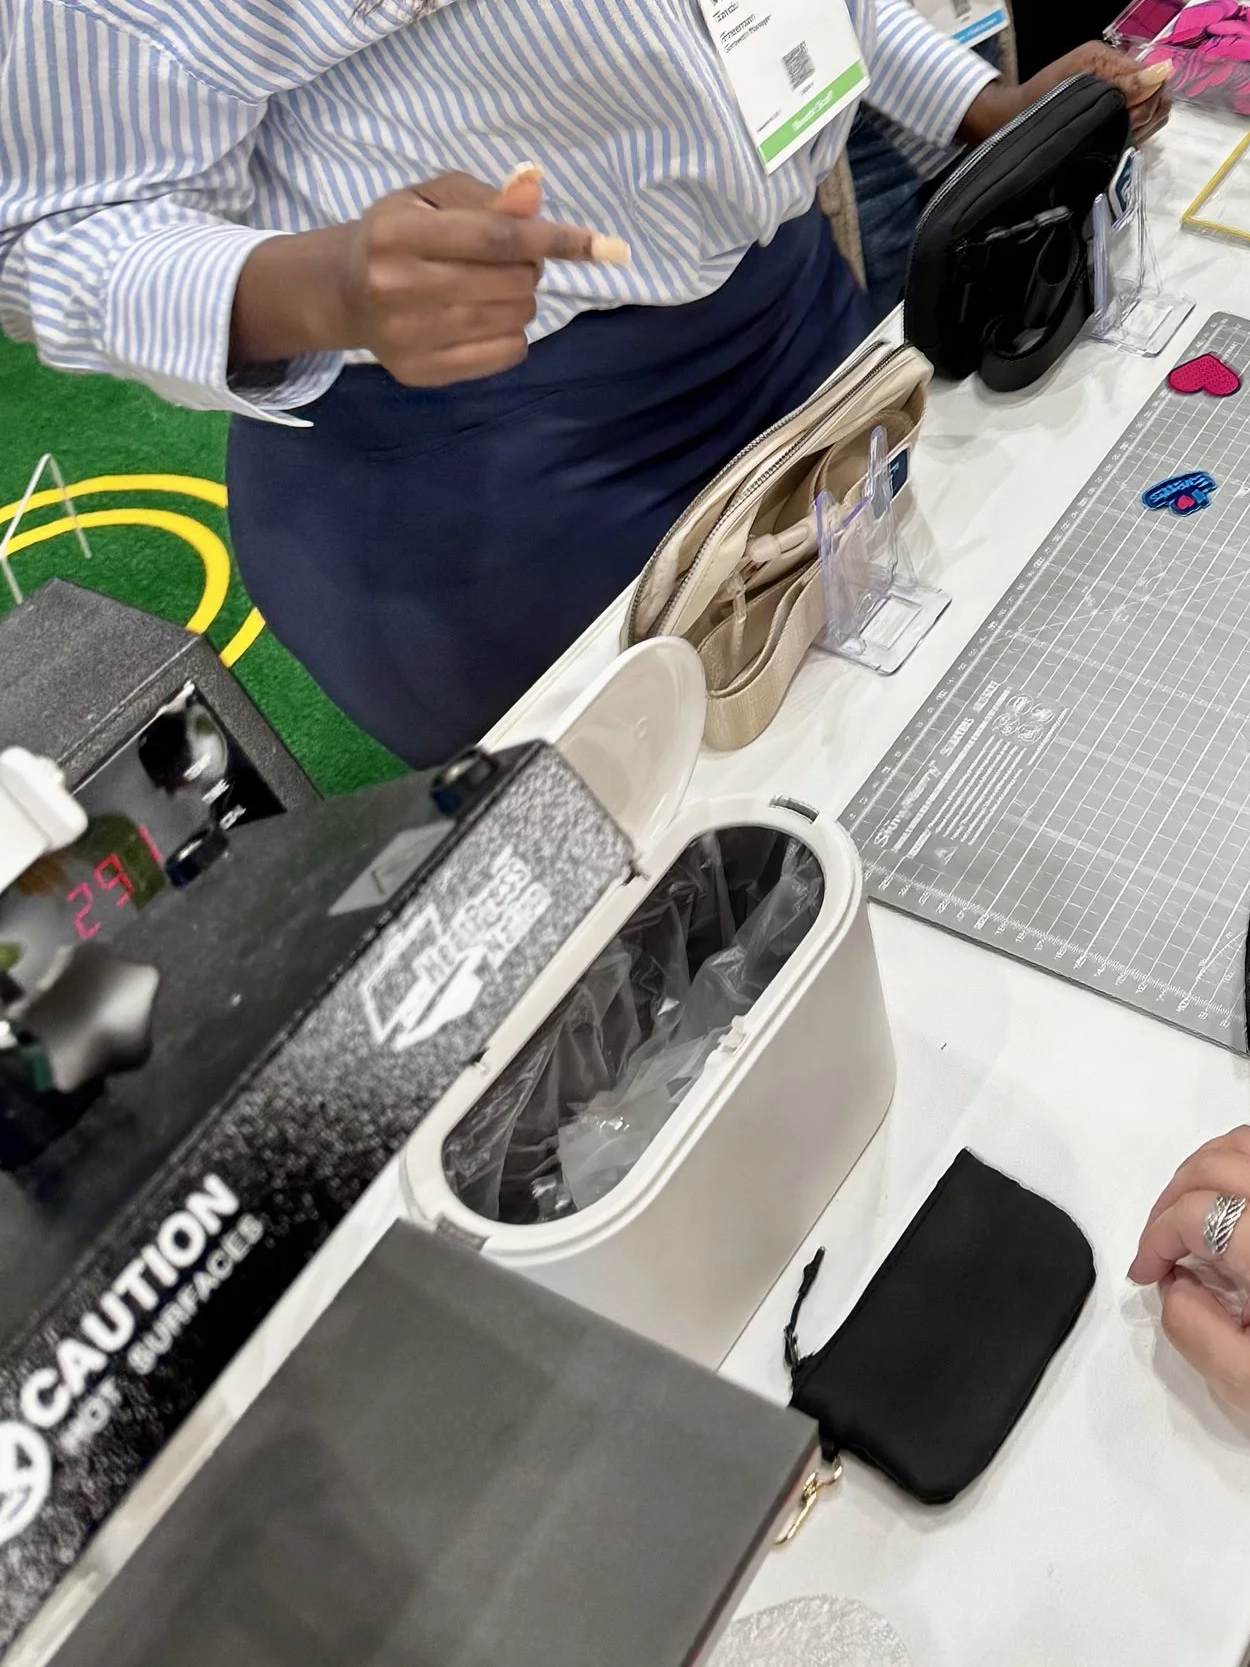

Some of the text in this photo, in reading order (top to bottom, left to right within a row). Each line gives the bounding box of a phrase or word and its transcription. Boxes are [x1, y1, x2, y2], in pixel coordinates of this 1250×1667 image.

[20, 1173, 240, 1428] CAUTION
[58, 1212, 265, 1455] HOT SURFACES
